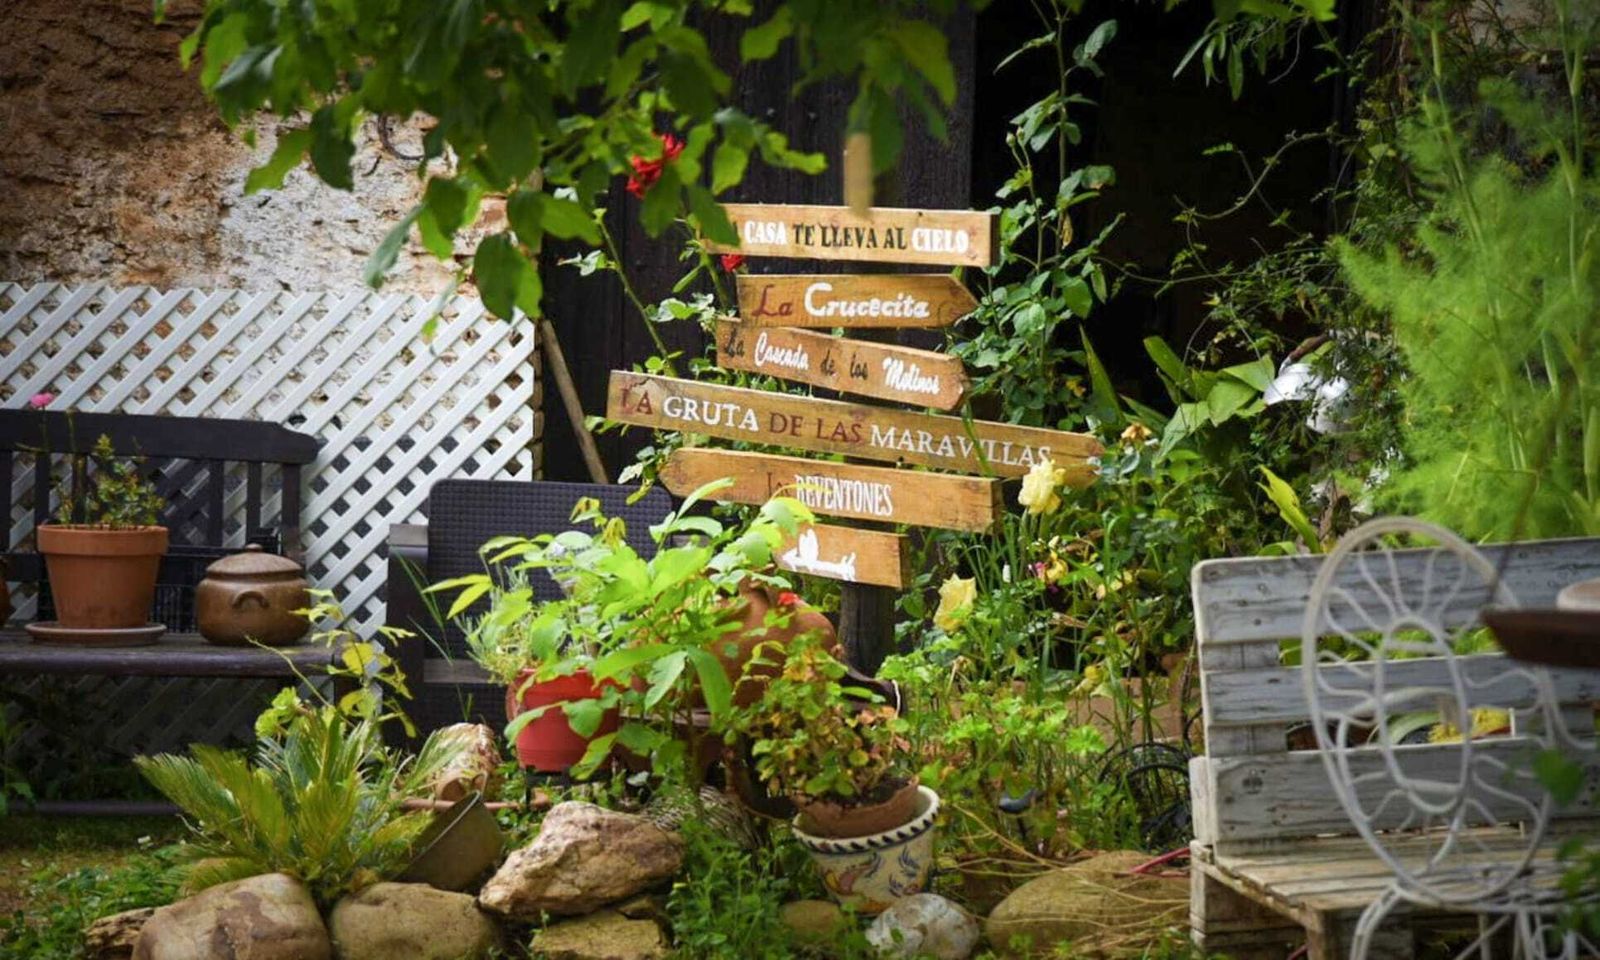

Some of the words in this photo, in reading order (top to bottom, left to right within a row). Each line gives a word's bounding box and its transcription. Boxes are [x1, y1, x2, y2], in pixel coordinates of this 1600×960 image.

[743, 220, 788, 246] CASA
[792, 222, 815, 247] TE
[818, 222, 878, 249] LLEVA
[884, 224, 907, 250] AL
[911, 226, 970, 253] CIELO
[751, 284, 793, 317] La
[804, 281, 931, 318] Crucecita
[754, 331, 809, 370] Cascada
[882, 356, 941, 395] Molinos
[618, 387, 653, 416] LA
[662, 395, 760, 432] GRUTA
[769, 411, 804, 438] DE
[815, 416, 863, 444] LAS
[794, 473, 893, 517] REVENTONES
